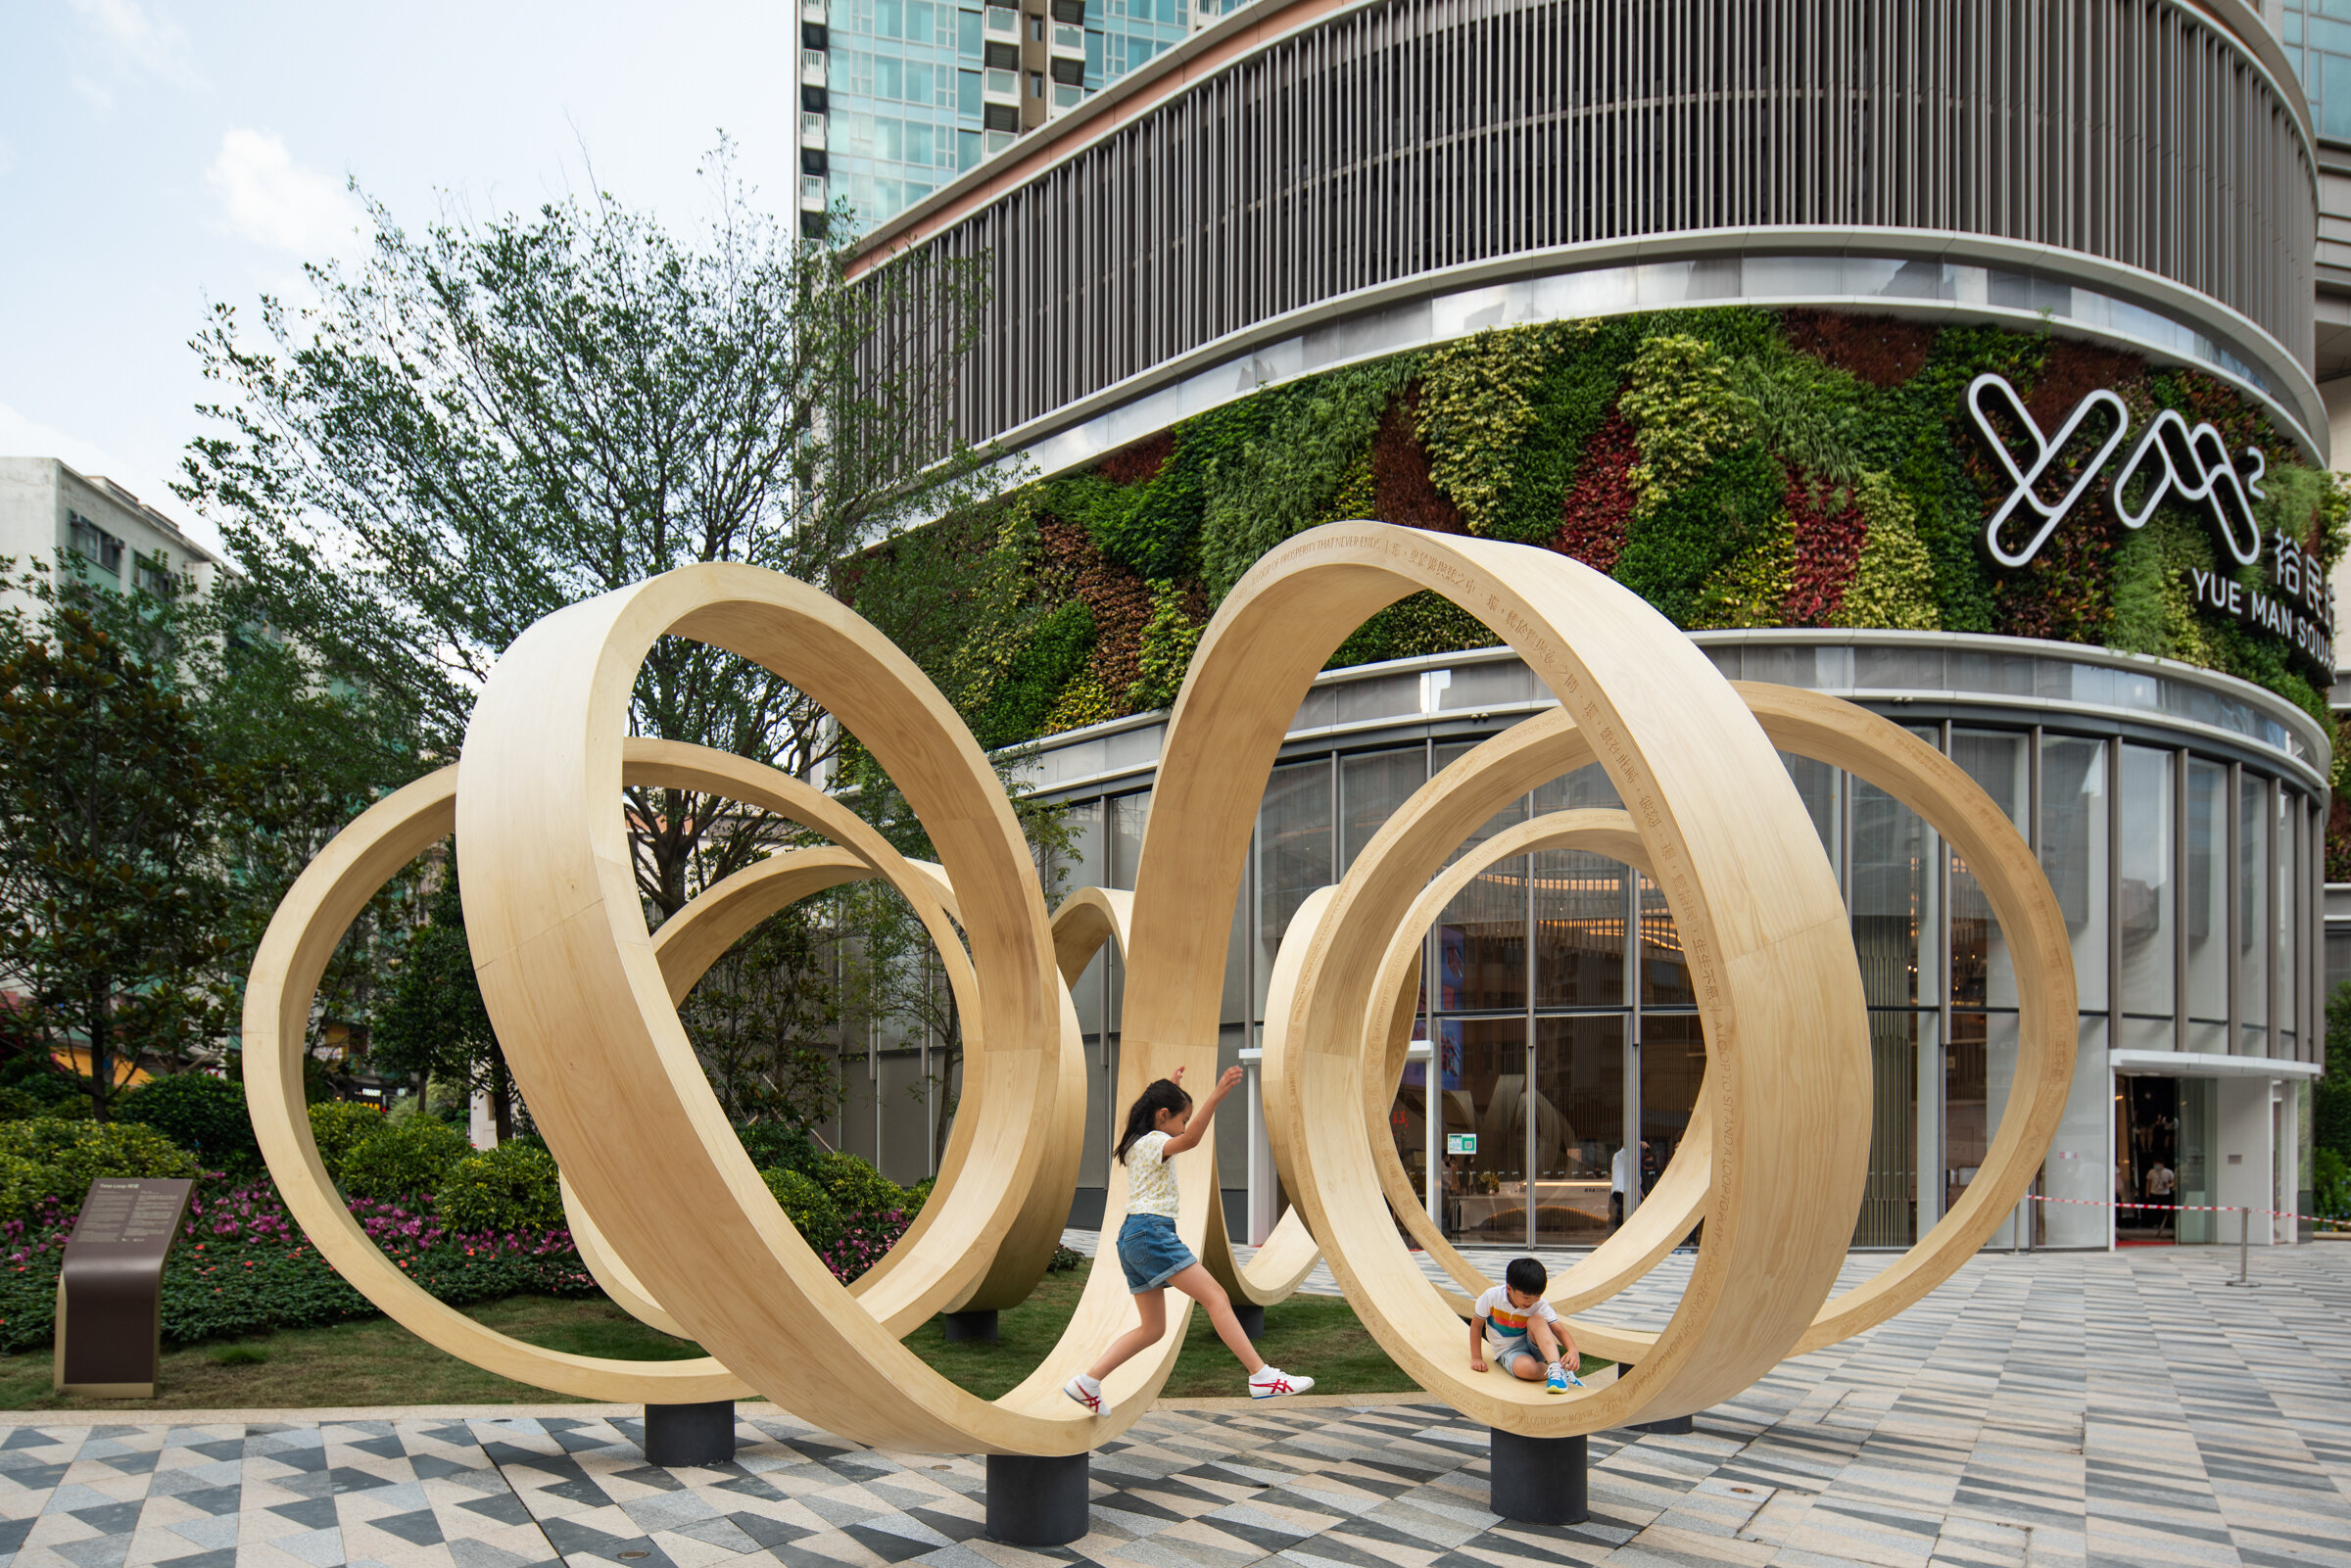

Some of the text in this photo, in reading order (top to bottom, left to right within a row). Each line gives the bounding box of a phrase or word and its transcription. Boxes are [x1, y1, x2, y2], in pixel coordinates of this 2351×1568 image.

[1275, 541, 1318, 565] PROSPERITY
[1315, 537, 1336, 551] THAT
[1334, 536, 1359, 548] NEVER
[1359, 536, 1382, 549] ENDS
[2191, 566, 2338, 685] YUE MAN SQUA
[1711, 1020, 1736, 1241] A LOOP TO SIT AND A LOOP TO PLAY
[1707, 1248, 1721, 1261] A
[1691, 1287, 1708, 1310] FOR
[1676, 1304, 1702, 1339] NIGHT
[1666, 1331, 1687, 1355] AND
[1647, 1353, 1672, 1379] LOOP
[1596, 1397, 1620, 1415] LOOP
